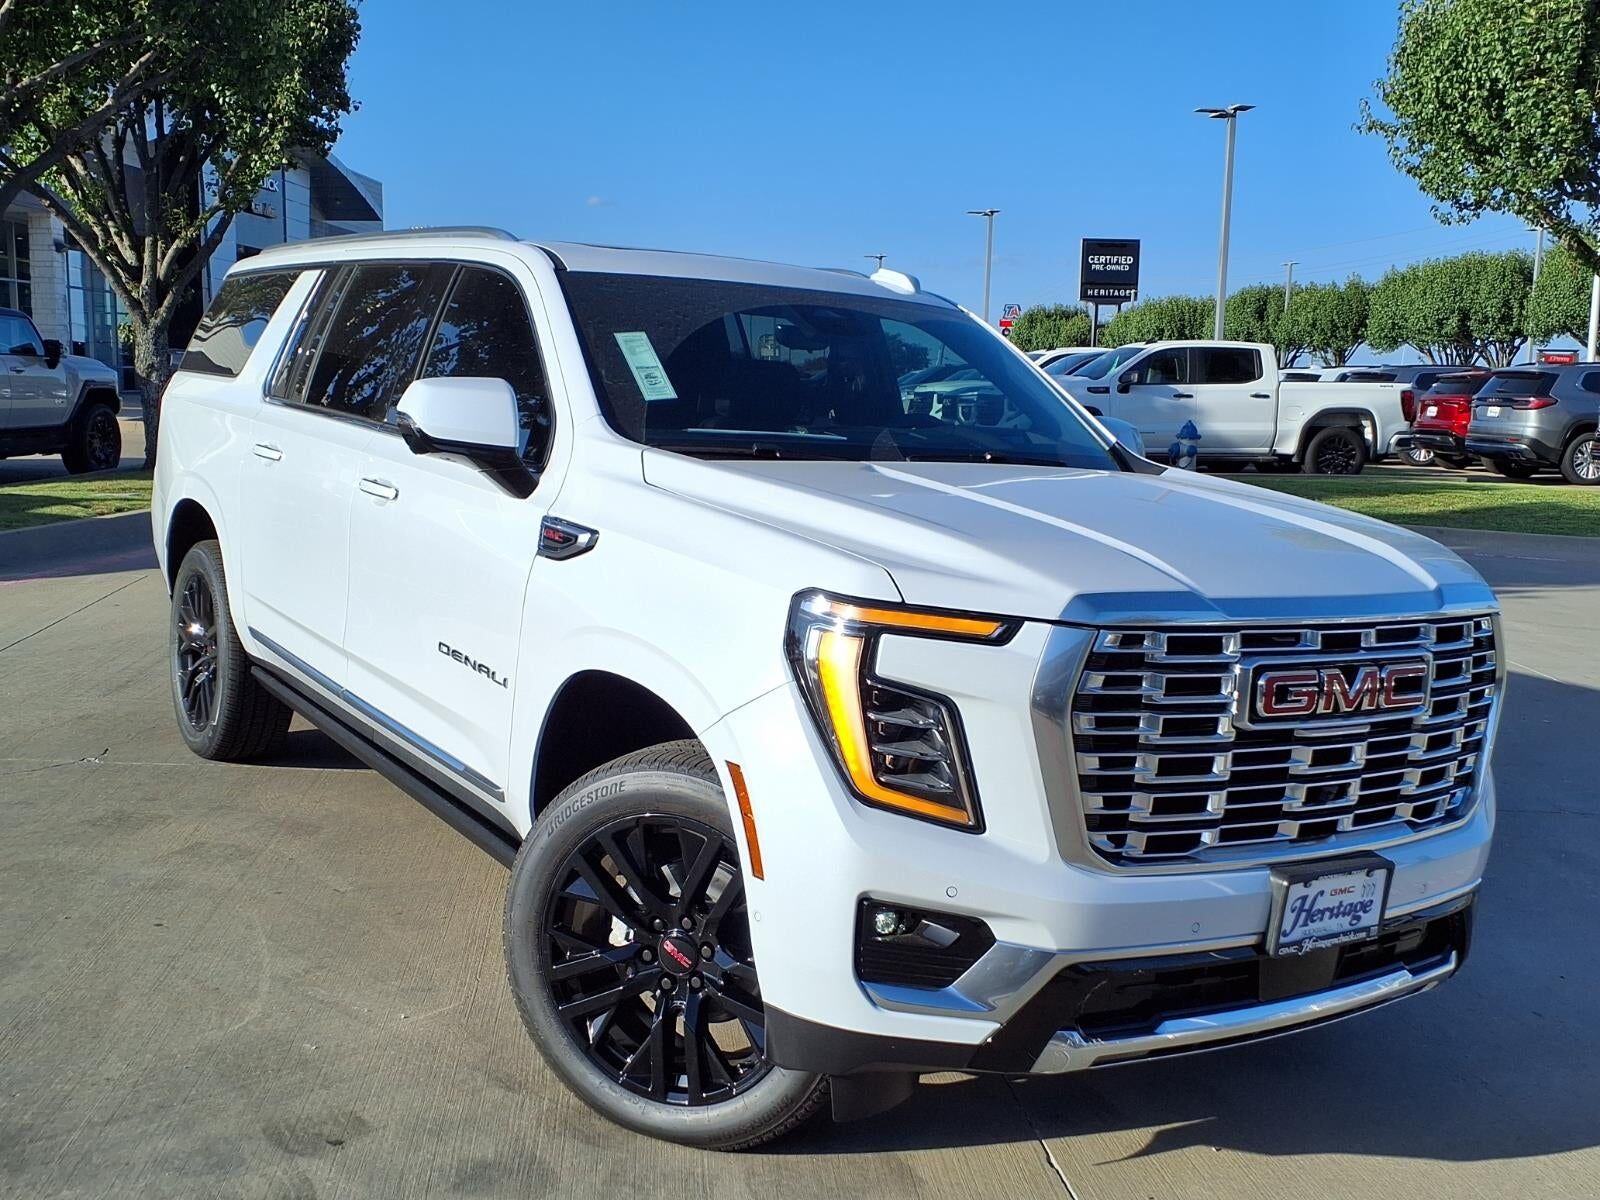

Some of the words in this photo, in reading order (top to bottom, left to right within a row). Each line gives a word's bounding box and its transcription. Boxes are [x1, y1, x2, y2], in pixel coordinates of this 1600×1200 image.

[1088, 256, 1134, 264] CERTIFIED
[1088, 288, 1133, 297] HERITAGE
[438, 641, 508, 689] DENALI
[1256, 664, 1427, 717] GMC
[547, 780, 626, 838] BRIDGESTONE
[1281, 890, 1374, 938] Heritage
[1329, 885, 1356, 896] GMC
